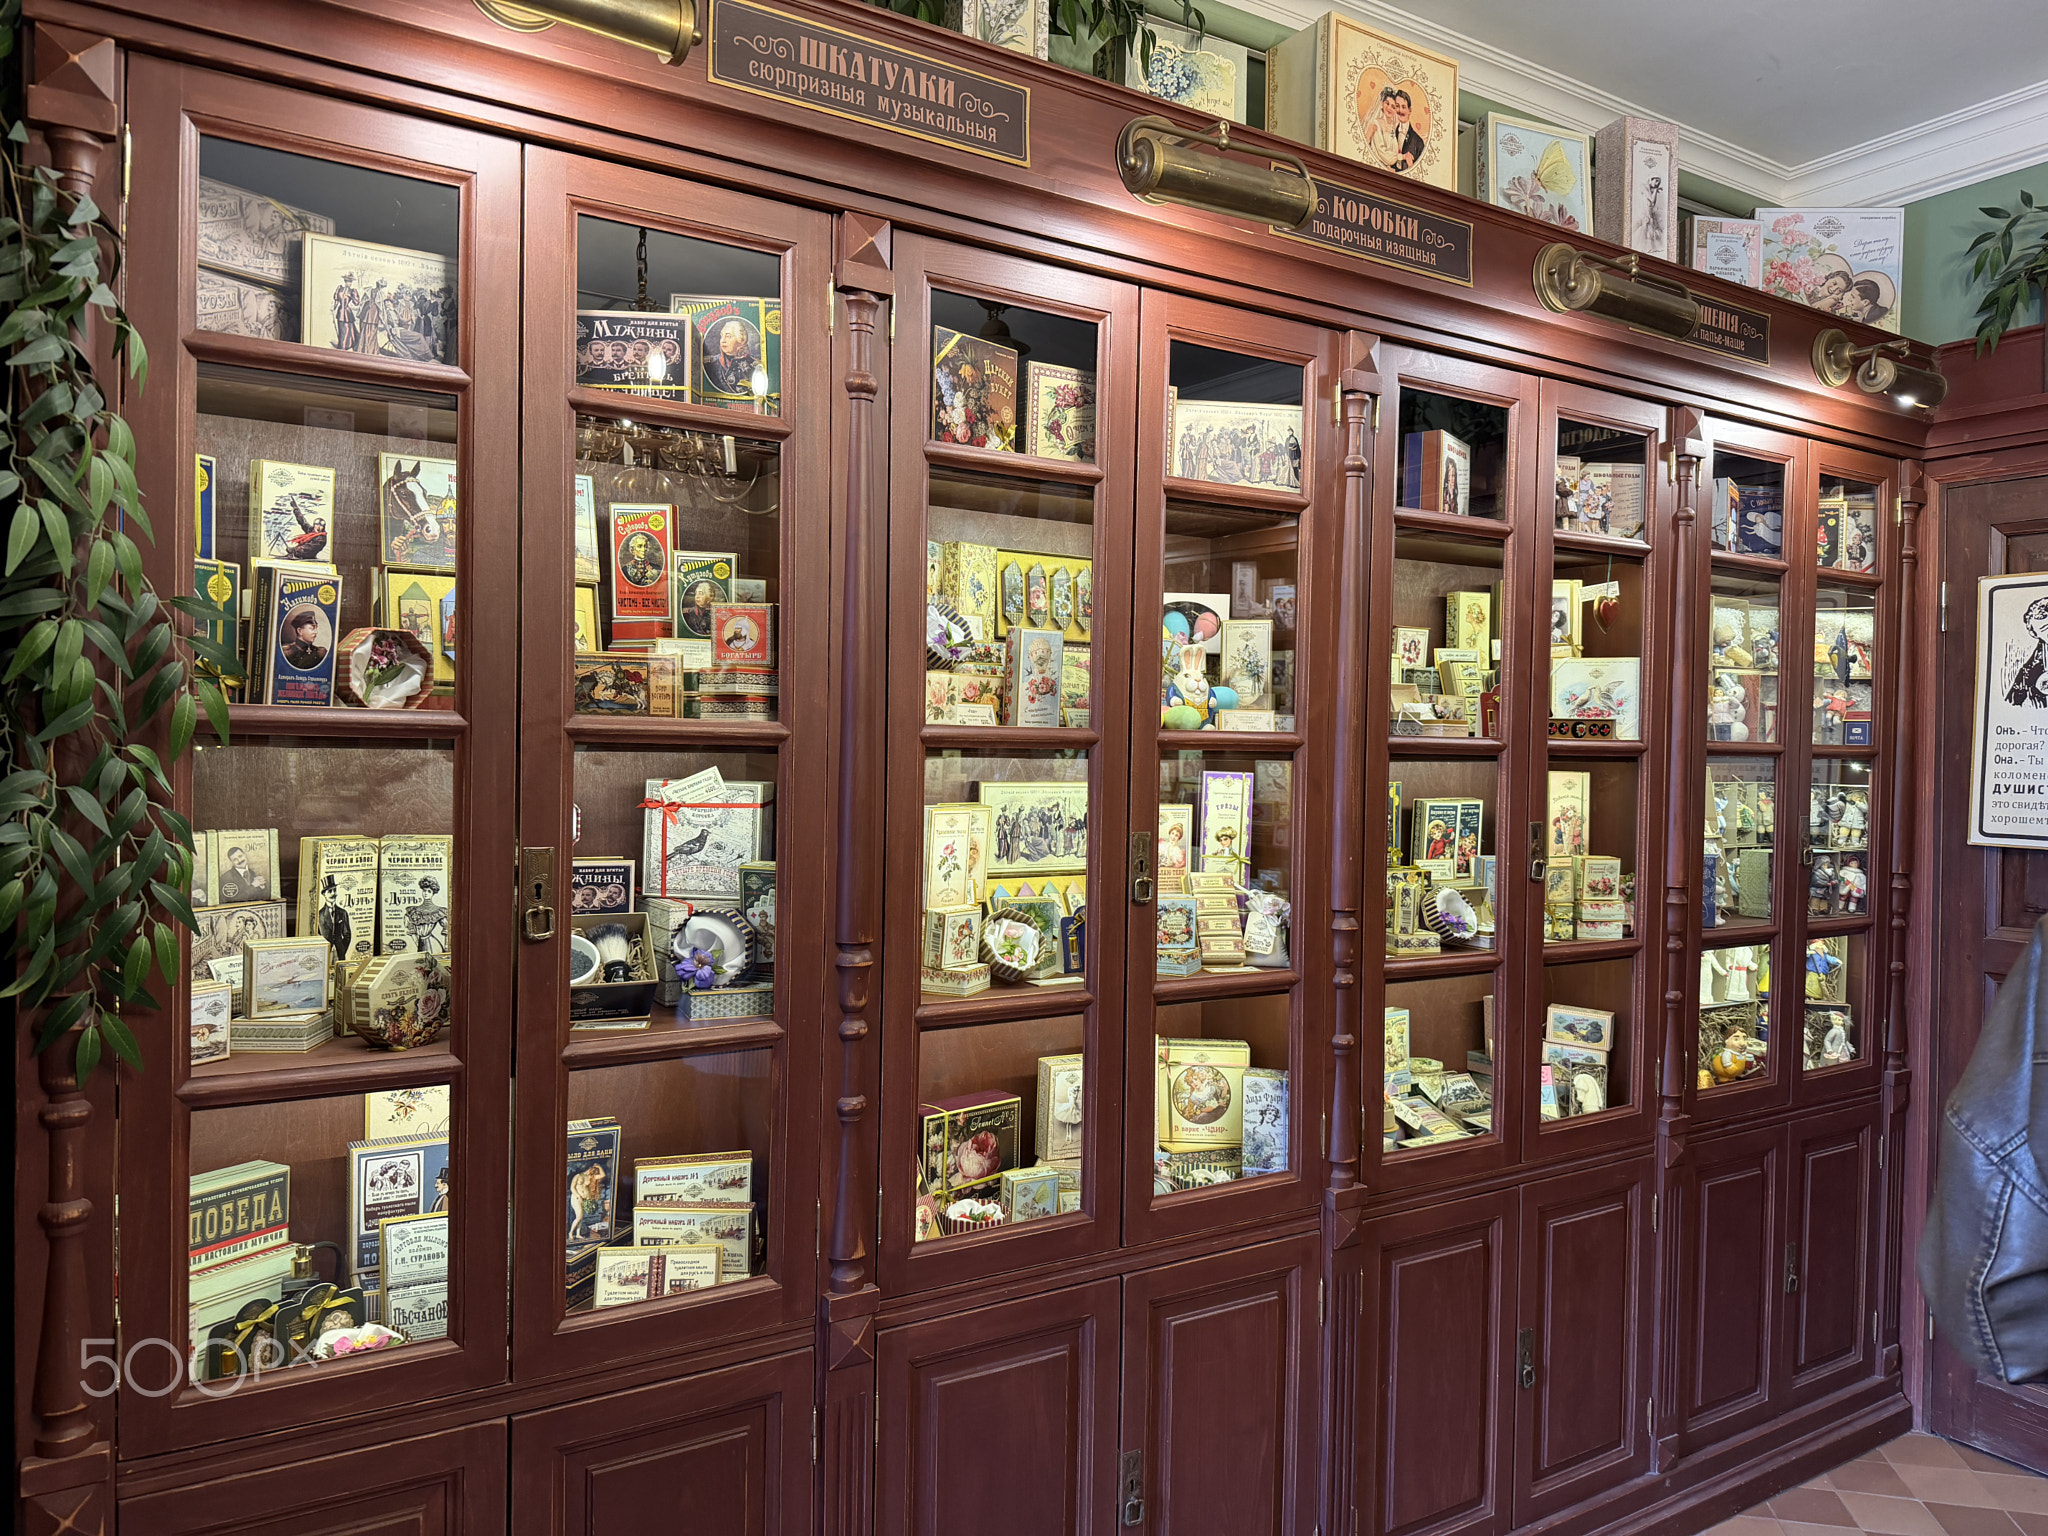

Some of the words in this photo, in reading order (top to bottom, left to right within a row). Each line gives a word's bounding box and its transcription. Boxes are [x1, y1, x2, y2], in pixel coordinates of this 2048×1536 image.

[799, 35, 956, 108] ШКАТУЛКИ
[749, 59, 866, 107] сюрпризныя
[877, 95, 998, 144] музыкальныя
[1332, 195, 1419, 242] КОРОБКИ
[1312, 219, 1383, 252] подарочныя
[1385, 239, 1438, 266] изящныя
[1700, 328, 1745, 352] папье-маше
[1994, 740, 2045, 753] дорогая?
[2027, 754, 2044, 766] Ты
[1992, 783, 2048, 796] ДУШИС
[1991, 800, 2010, 809] это
[190, 1187, 284, 1246] ПОБЕДА
[204, 1242, 249, 1261] НАСТОЯЩИХ
[251, 1230, 284, 1248] МУЖЧИН
[410, 1251, 446, 1264] СУРАНОВЪ
